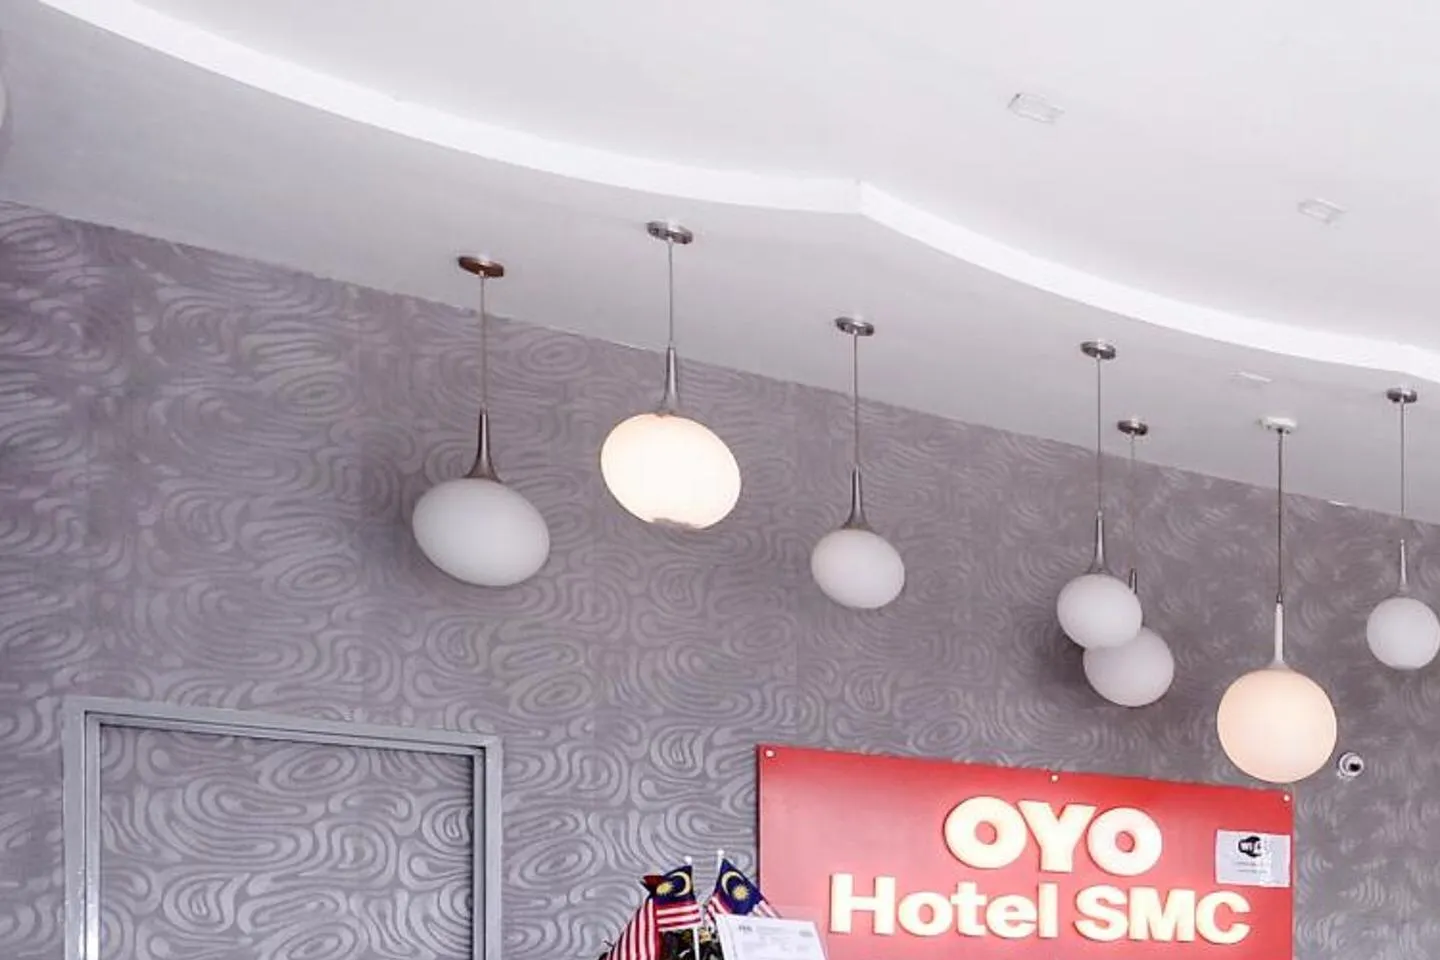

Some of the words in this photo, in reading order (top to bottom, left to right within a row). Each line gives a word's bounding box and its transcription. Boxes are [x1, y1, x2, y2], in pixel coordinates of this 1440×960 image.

[943, 796, 1163, 875] OYO
[830, 873, 1058, 938] Hotel
[1074, 884, 1251, 944] SMC
